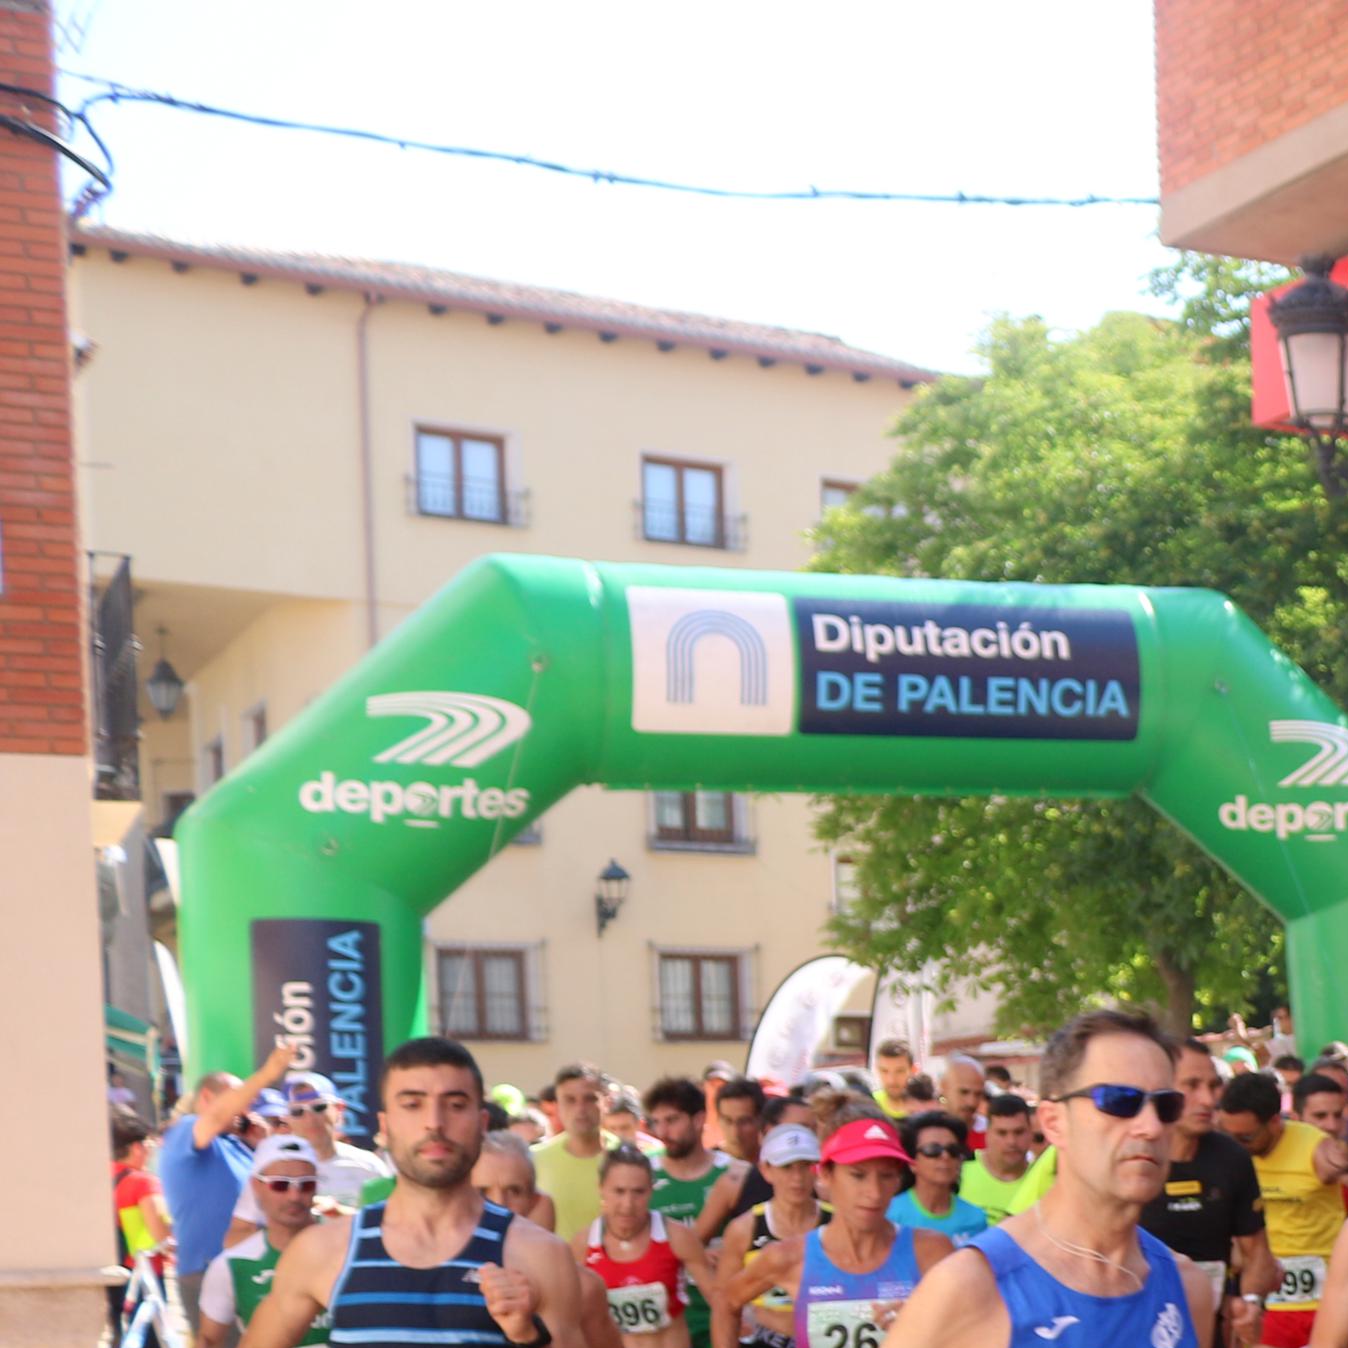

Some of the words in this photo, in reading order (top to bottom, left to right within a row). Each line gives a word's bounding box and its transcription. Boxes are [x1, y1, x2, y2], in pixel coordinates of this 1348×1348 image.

[812, 613, 1071, 663] Diputación
[816, 671, 884, 712] DE
[898, 674, 1130, 718] PALENCIA
[299, 770, 530, 825] deportes
[1277, 1270, 1315, 1296] 99
